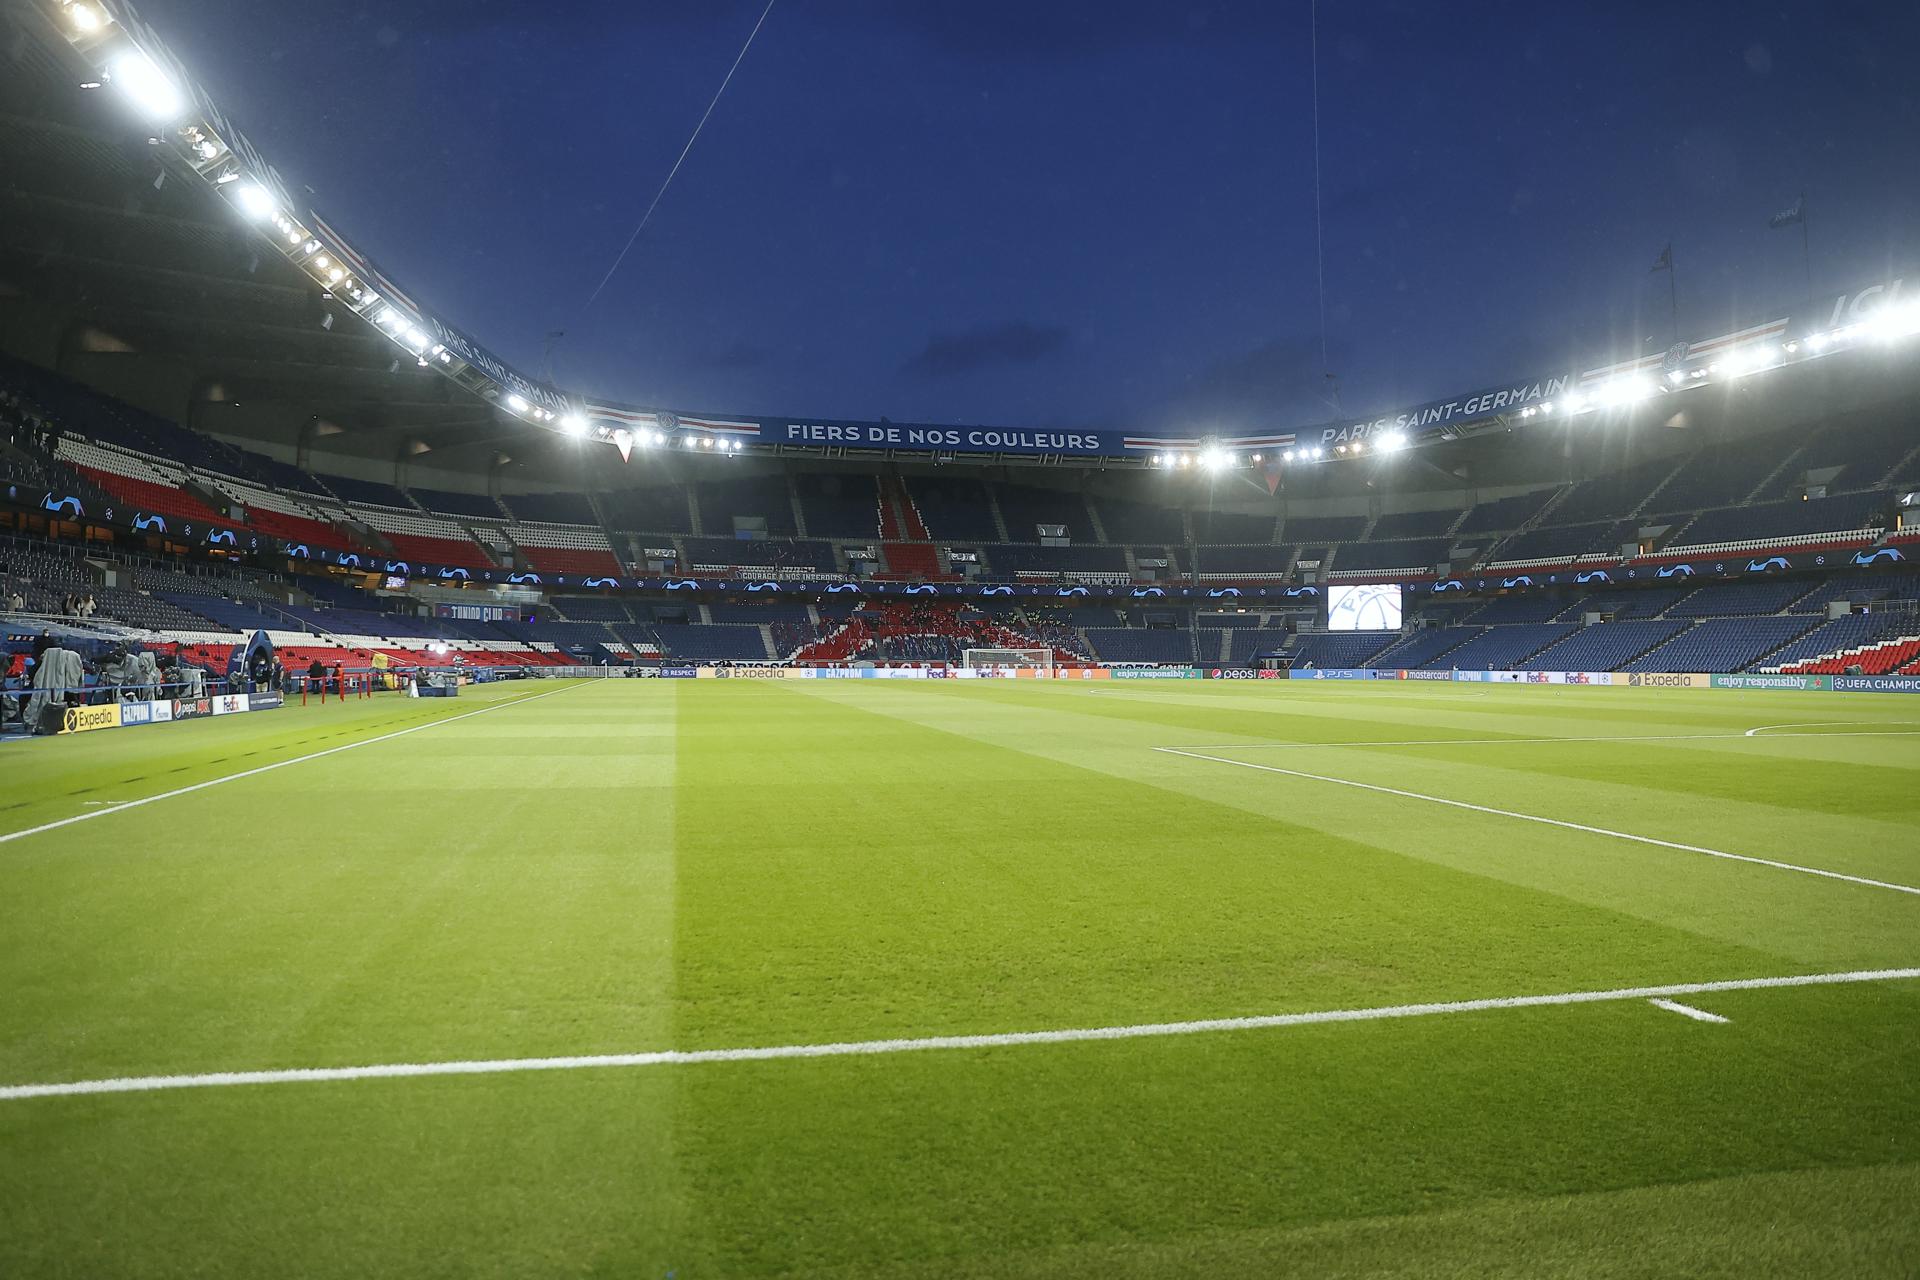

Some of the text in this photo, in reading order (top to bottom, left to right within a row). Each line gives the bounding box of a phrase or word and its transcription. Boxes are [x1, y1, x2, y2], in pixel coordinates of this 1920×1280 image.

[432, 317, 570, 412] PARIS SAINT-GERMAIN
[1320, 375, 1569, 445] PARIS SAINT-GERMAIN
[787, 424, 1100, 449] FIERS DE NOS COULEURS
[670, 669, 696, 677] RESPECT
[734, 668, 784, 678] Expedia
[826, 668, 862, 678] GAZPROM
[927, 668, 958, 679] FedEx
[1117, 669, 1186, 680] enjoy responsibly
[1224, 669, 1280, 680] pepsi MAX
[1409, 670, 1449, 680] mastercard
[1527, 672, 1549, 683] FedEx
[1565, 673, 1590, 684] FedEx
[1644, 673, 1691, 686] Expedia
[1718, 674, 1807, 689] enjoy responsibly
[1846, 679, 1872, 689] UEFA
[182, 705, 197, 713] pepsi
[223, 695, 240, 712] FedEx
[123, 702, 150, 722] GAZPROM
[79, 710, 113, 726] Expedia
